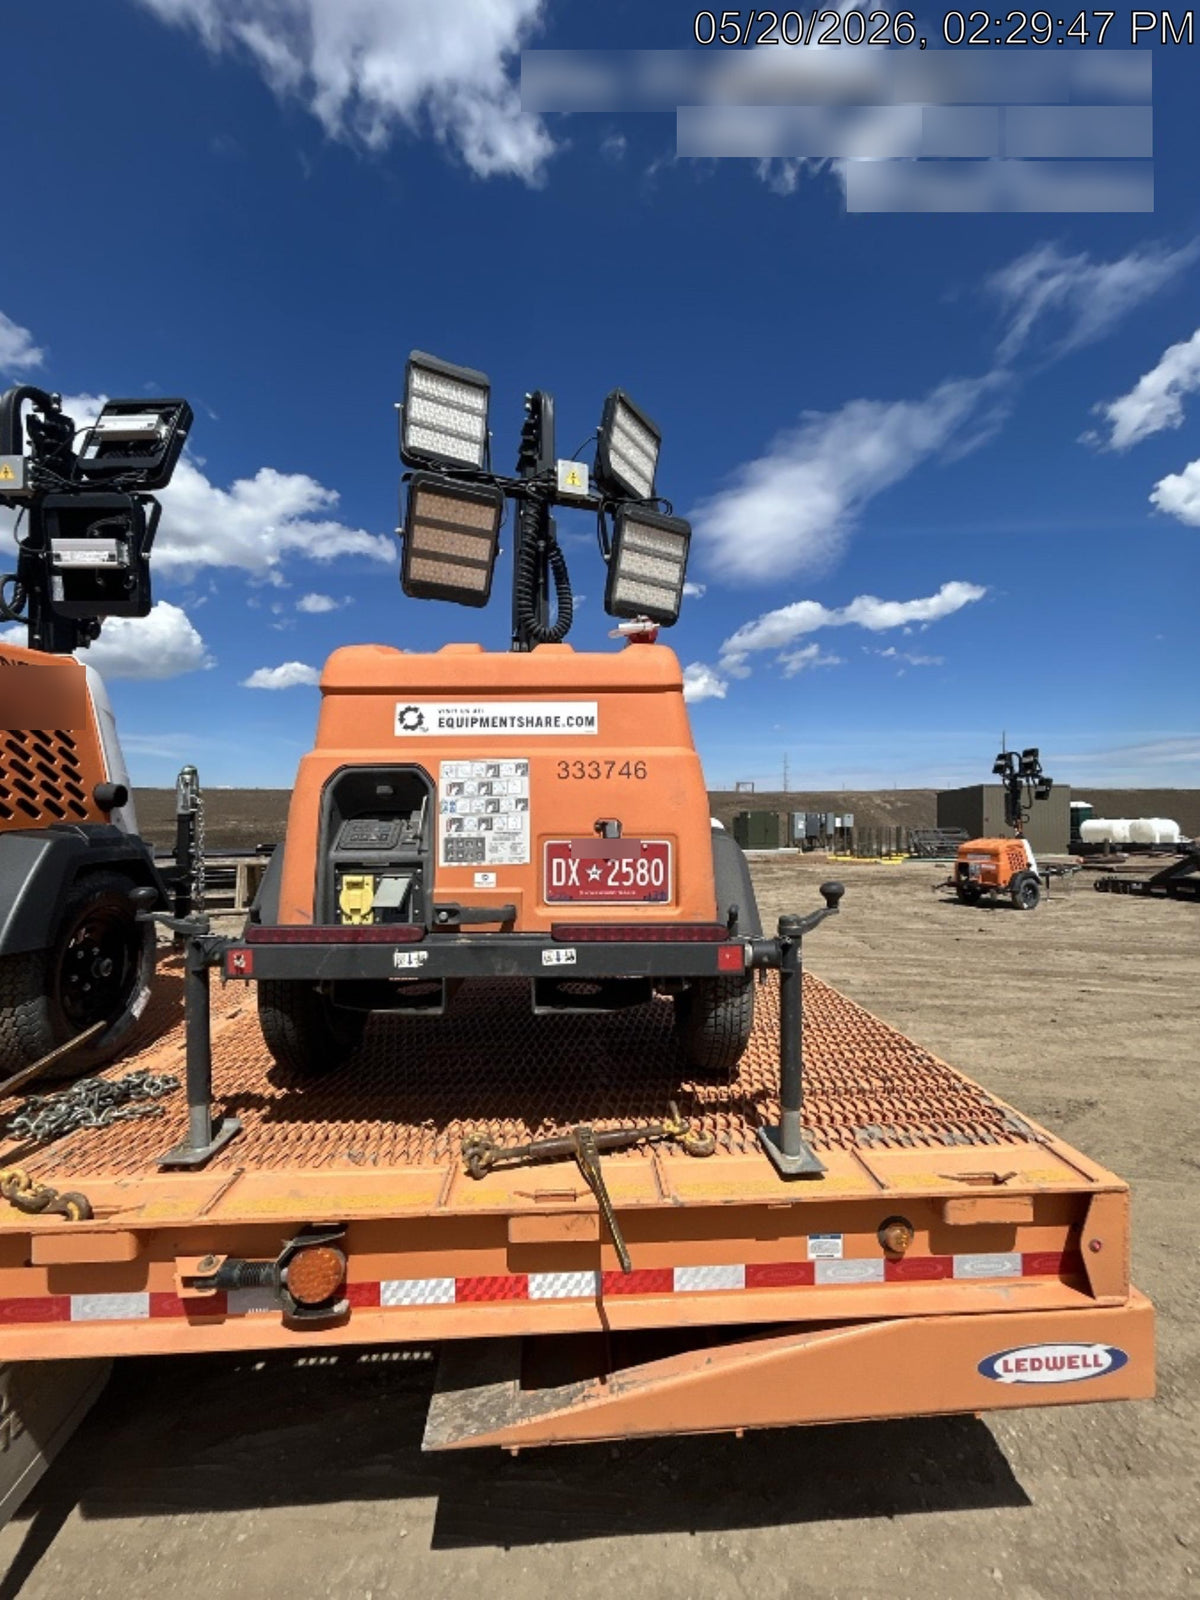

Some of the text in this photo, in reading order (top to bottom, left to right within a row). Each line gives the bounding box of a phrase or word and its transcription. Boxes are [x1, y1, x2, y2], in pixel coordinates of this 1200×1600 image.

[438, 715, 595, 729] EQUIPMENTSHARE.COM
[557, 760, 647, 780] 333746
[552, 858, 664, 886] DX 2580
[1002, 1354, 1103, 1374] LEDWELL
